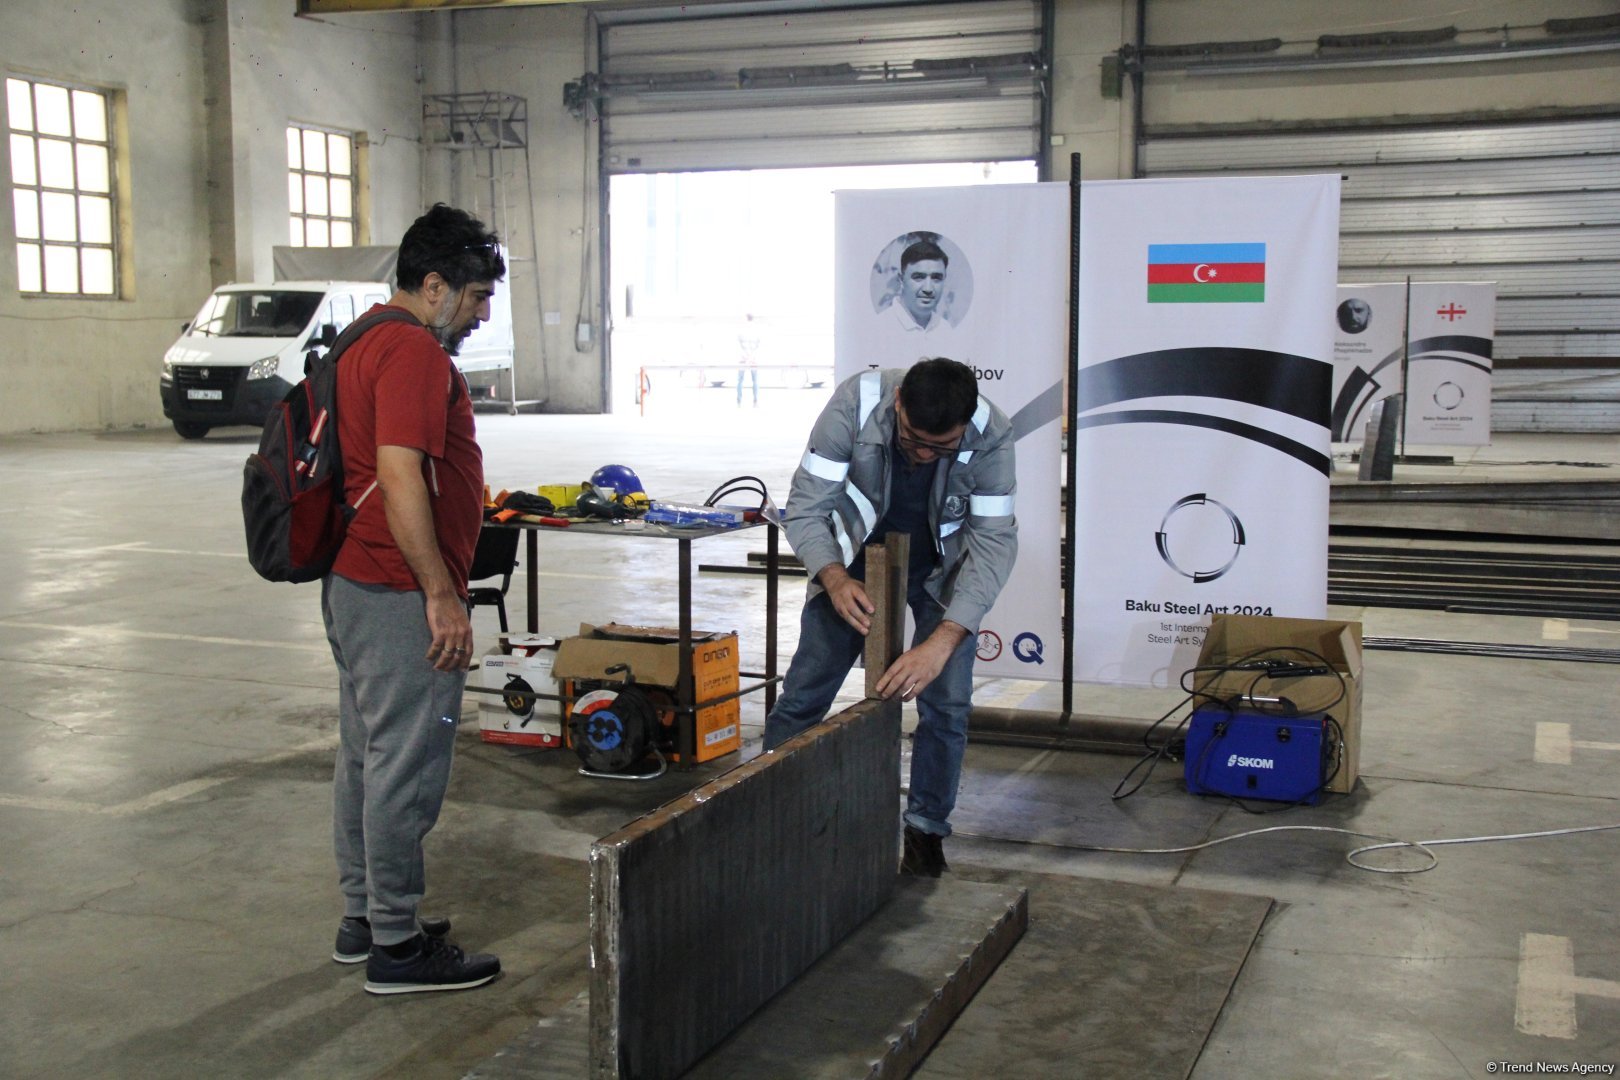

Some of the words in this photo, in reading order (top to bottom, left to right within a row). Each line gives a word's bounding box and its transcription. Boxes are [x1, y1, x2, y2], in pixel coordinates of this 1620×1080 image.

[1125, 599, 1161, 613] Baku
[1164, 601, 1201, 615] Steel
[1204, 604, 1229, 615] Art
[1233, 605, 1273, 617] 2024
[1160, 622, 1173, 632] 1st
[1174, 623, 1209, 634] Interna
[1147, 633, 1172, 644] Steel
[1174, 637, 1190, 645] Art
